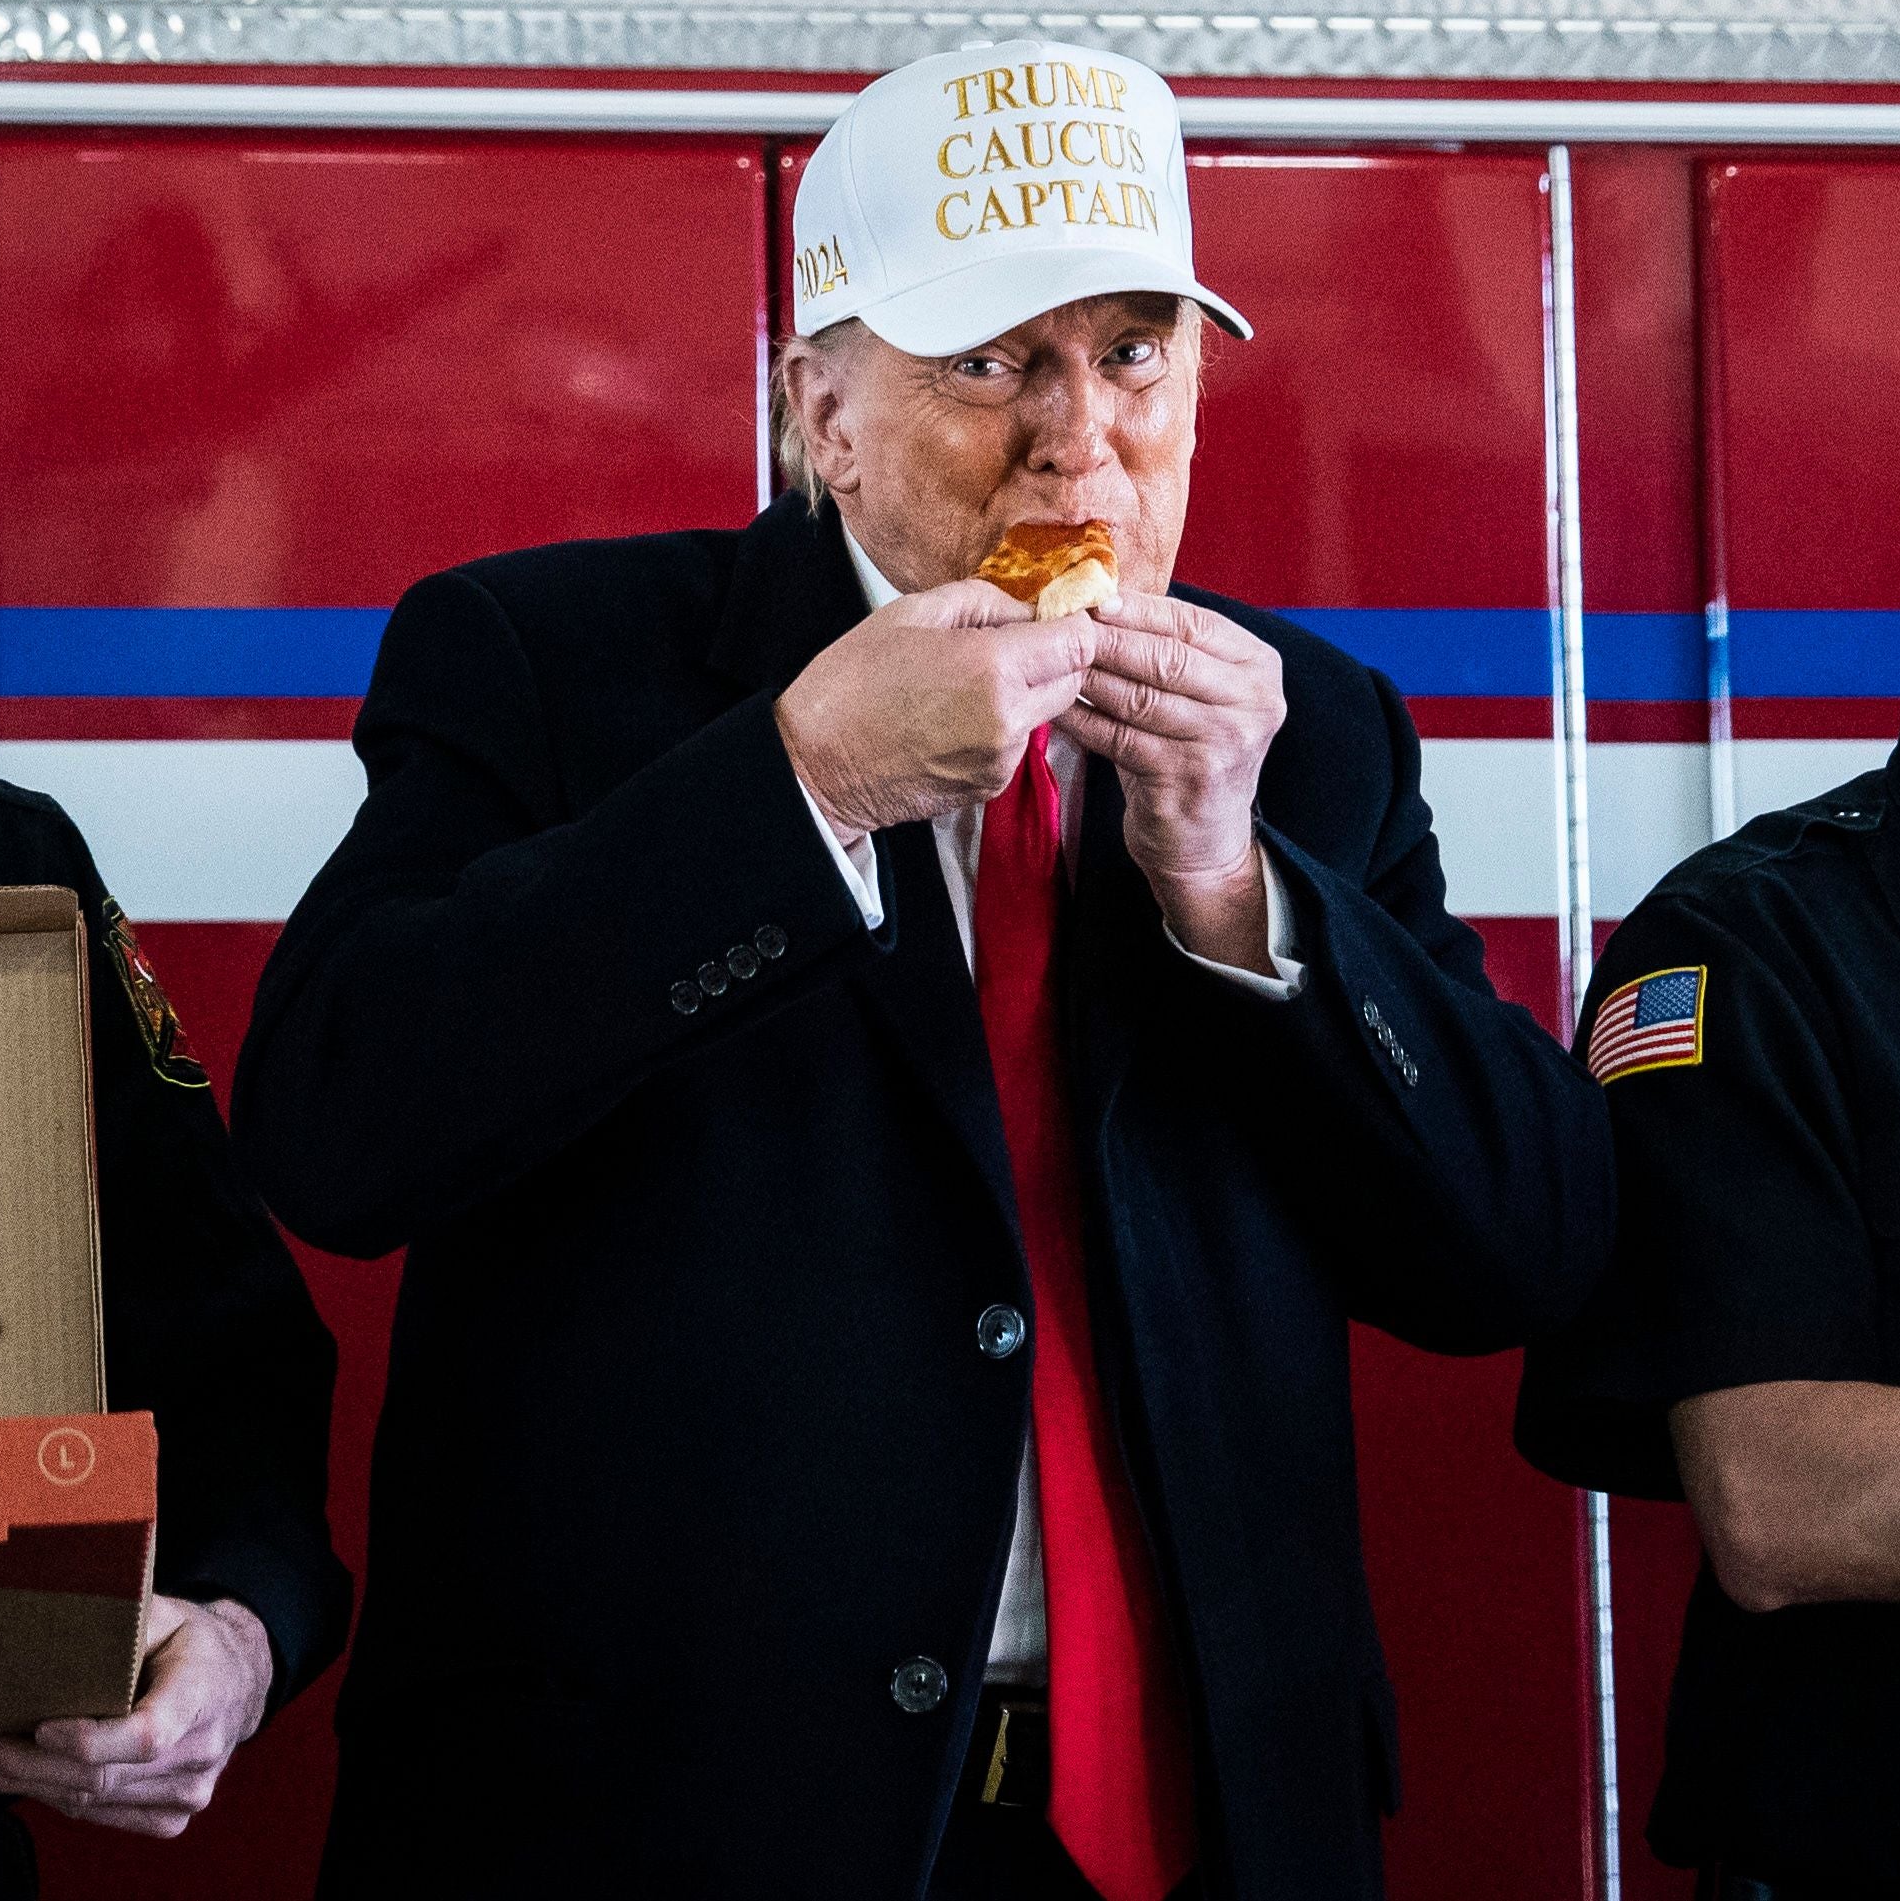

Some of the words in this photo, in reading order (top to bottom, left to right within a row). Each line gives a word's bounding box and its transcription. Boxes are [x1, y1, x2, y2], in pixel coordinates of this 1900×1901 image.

[944, 61, 1128, 121] TRUMP
[936, 120, 1146, 180] CAUCUS
[935, 179, 1160, 241] CAPTAIN
[796, 234, 849, 303] 2024
[60, 1445, 75, 1469] L
